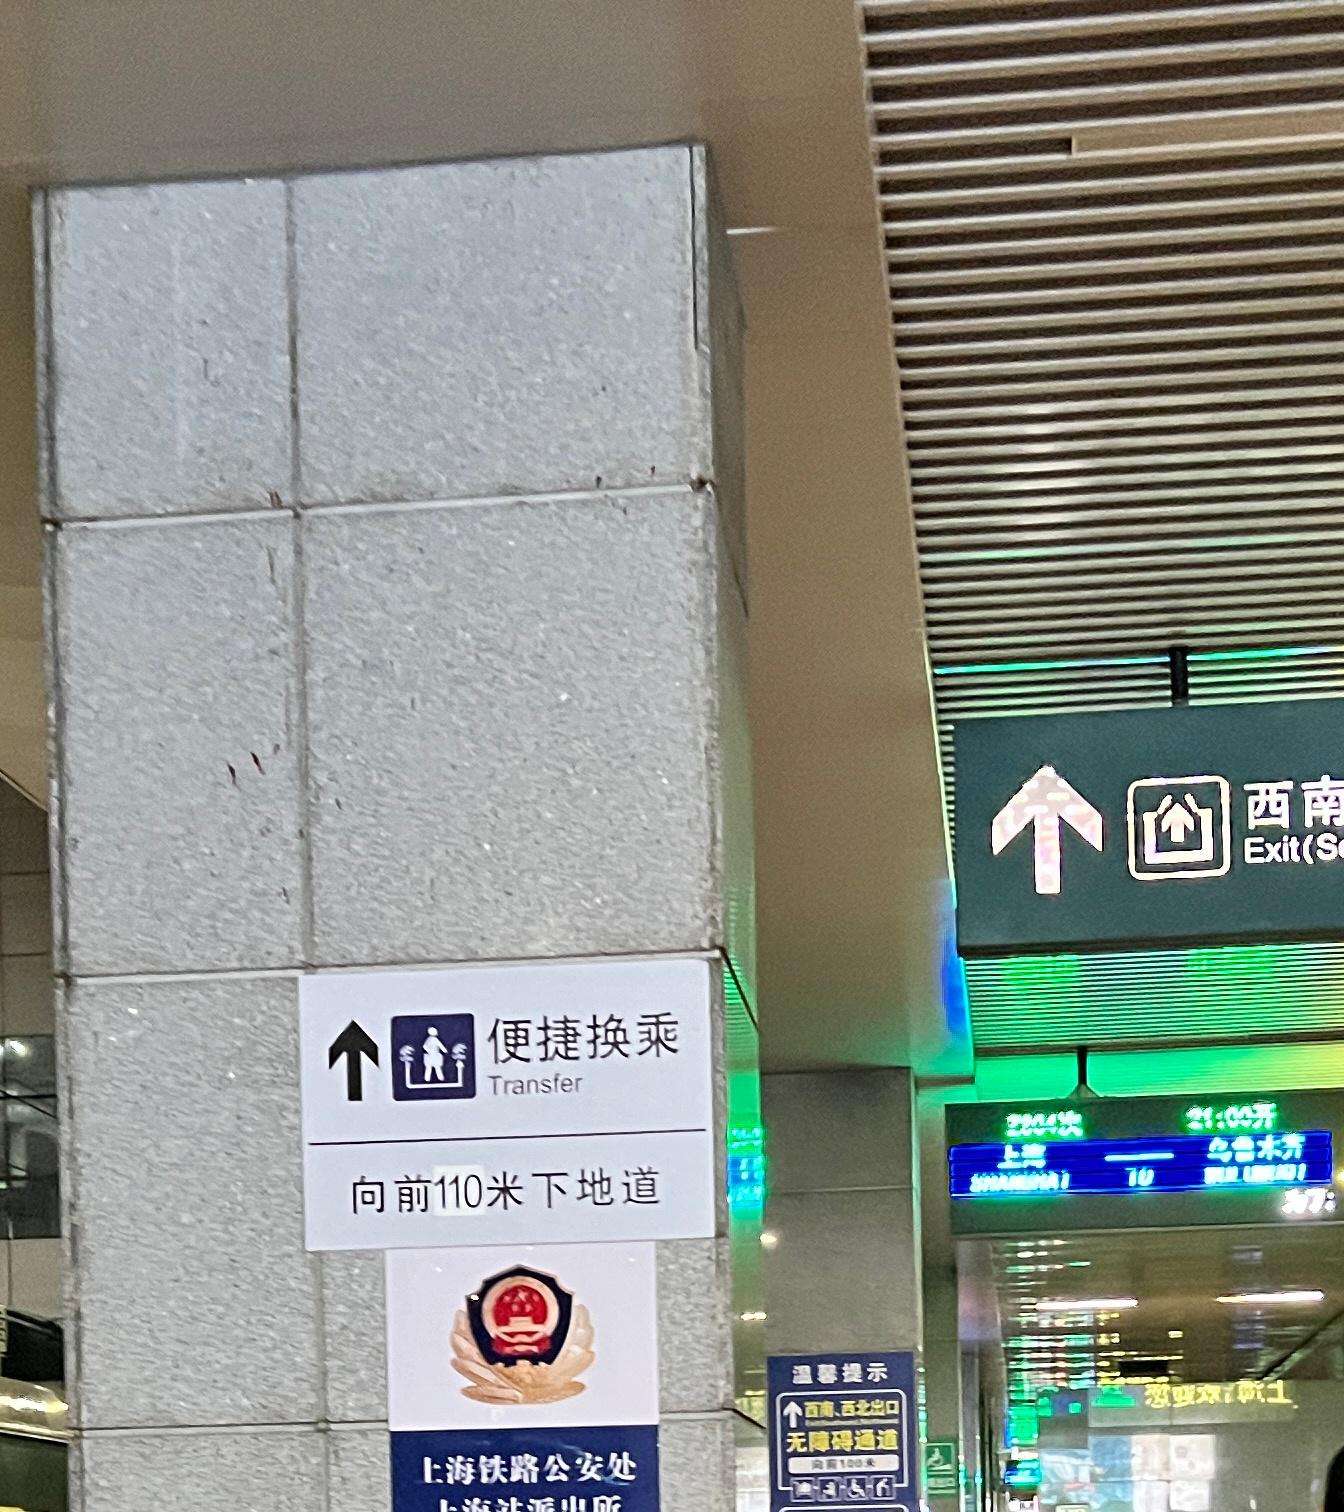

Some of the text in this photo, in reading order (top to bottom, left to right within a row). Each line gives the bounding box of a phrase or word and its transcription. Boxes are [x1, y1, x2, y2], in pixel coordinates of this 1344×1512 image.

[487, 1012, 679, 1064] 便捷换乘
[488, 1074, 583, 1096] Transfer
[352, 1166, 660, 1214] 向前110米下地道
[786, 1429, 899, 1452] 无障碍通道
[419, 1451, 637, 1485] 上海铁路公安处
